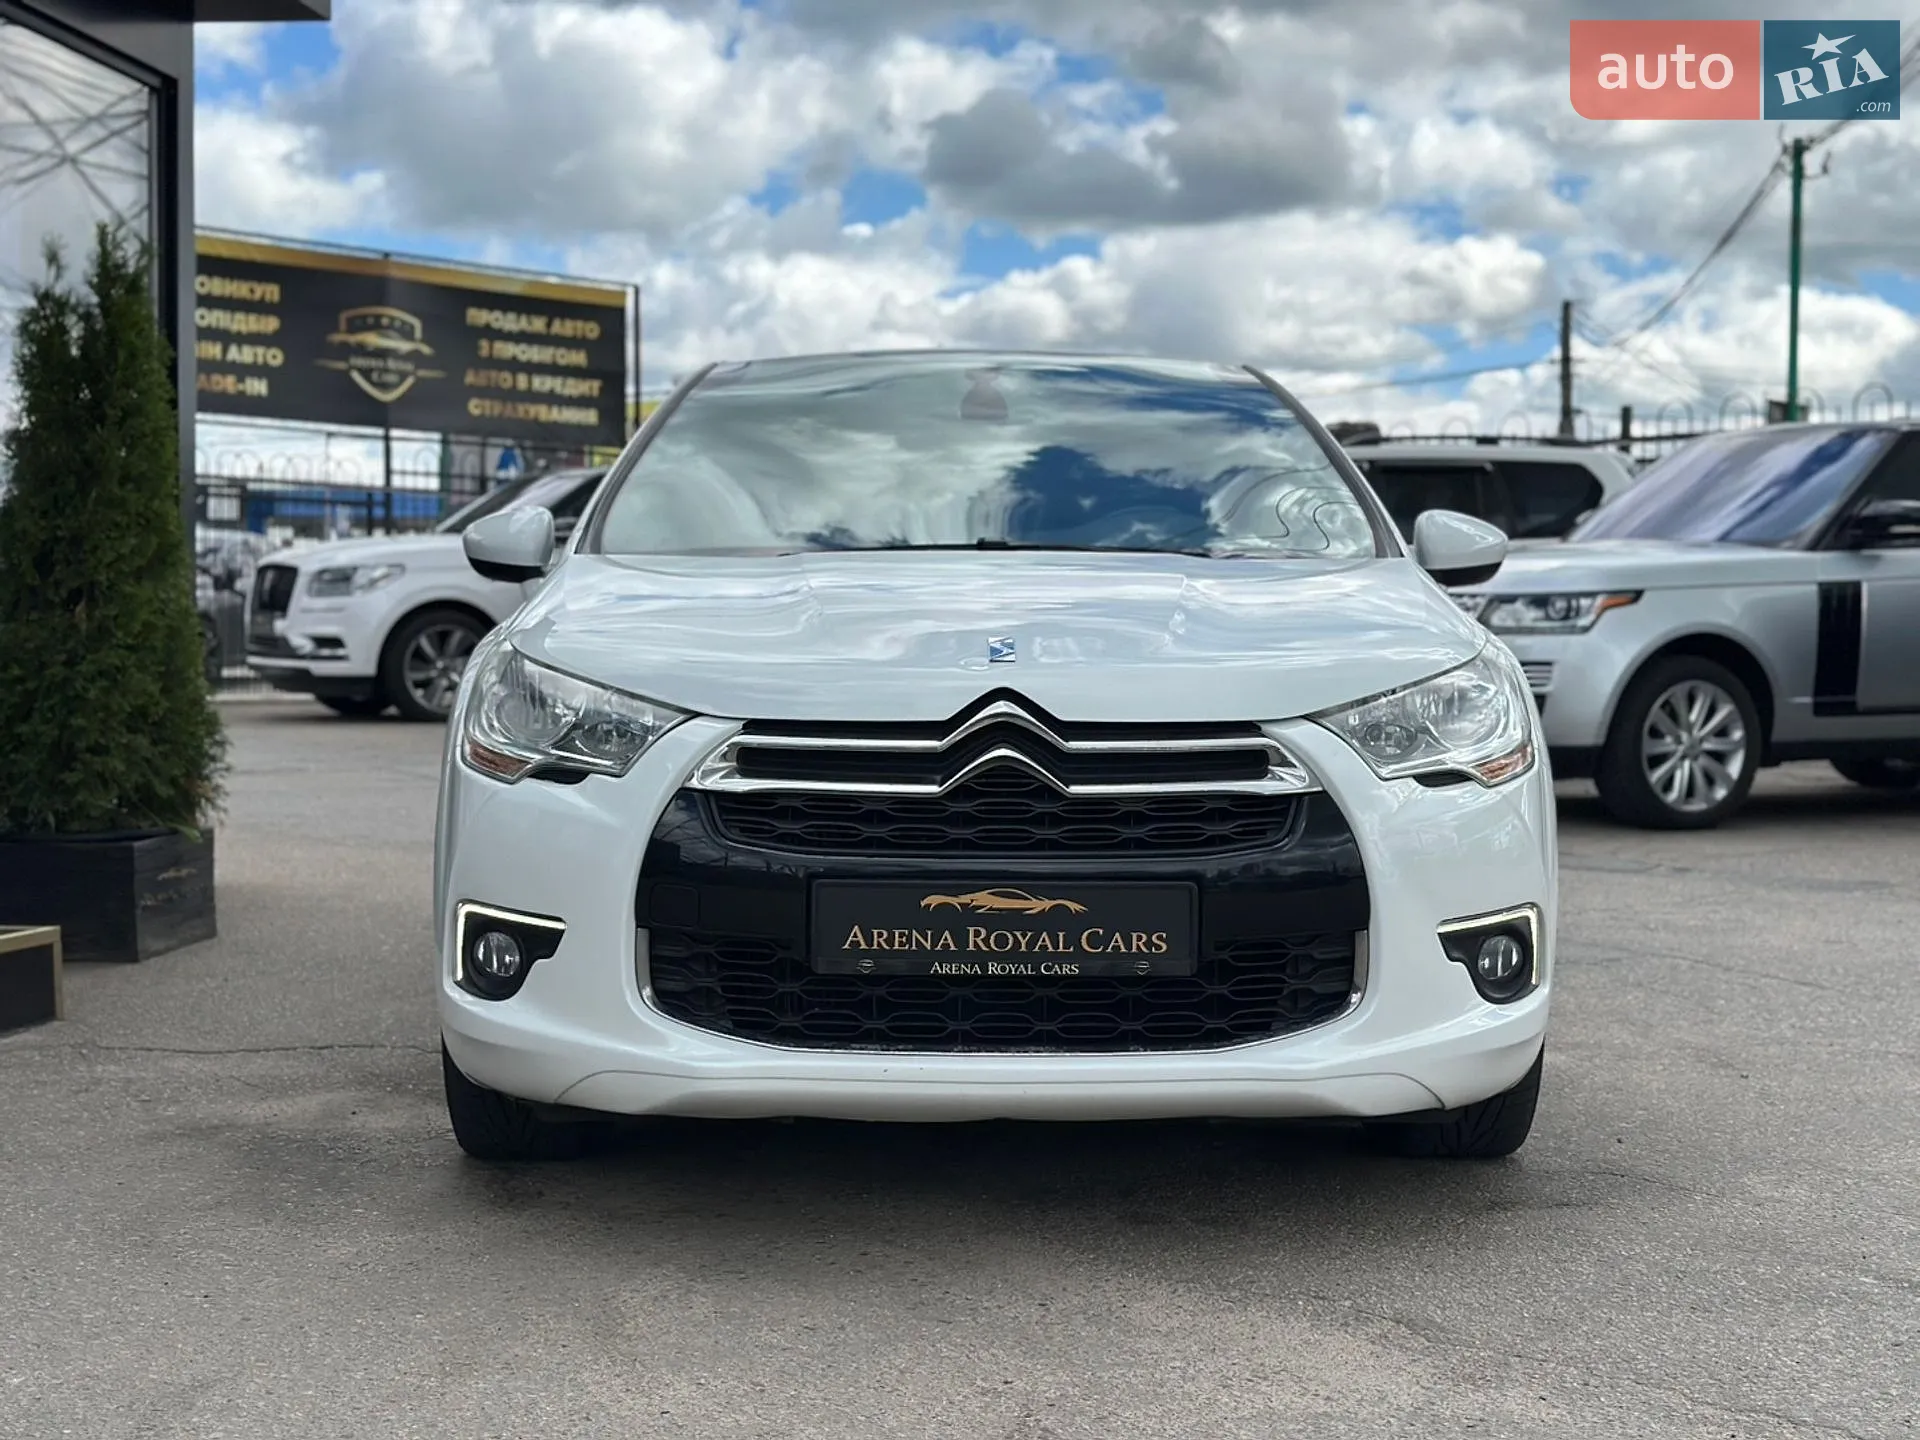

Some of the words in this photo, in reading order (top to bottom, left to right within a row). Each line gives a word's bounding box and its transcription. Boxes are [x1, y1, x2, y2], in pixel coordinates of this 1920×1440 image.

[550, 317, 601, 340] АВТО
[225, 343, 285, 367] АВТО
[842, 925, 958, 951] ARENA
[966, 926, 1074, 952] ROYAL
[1080, 927, 1168, 953] CARS
[930, 961, 982, 975] ARENA
[987, 961, 1036, 976] ROYAL
[1040, 962, 1080, 975] CARS
